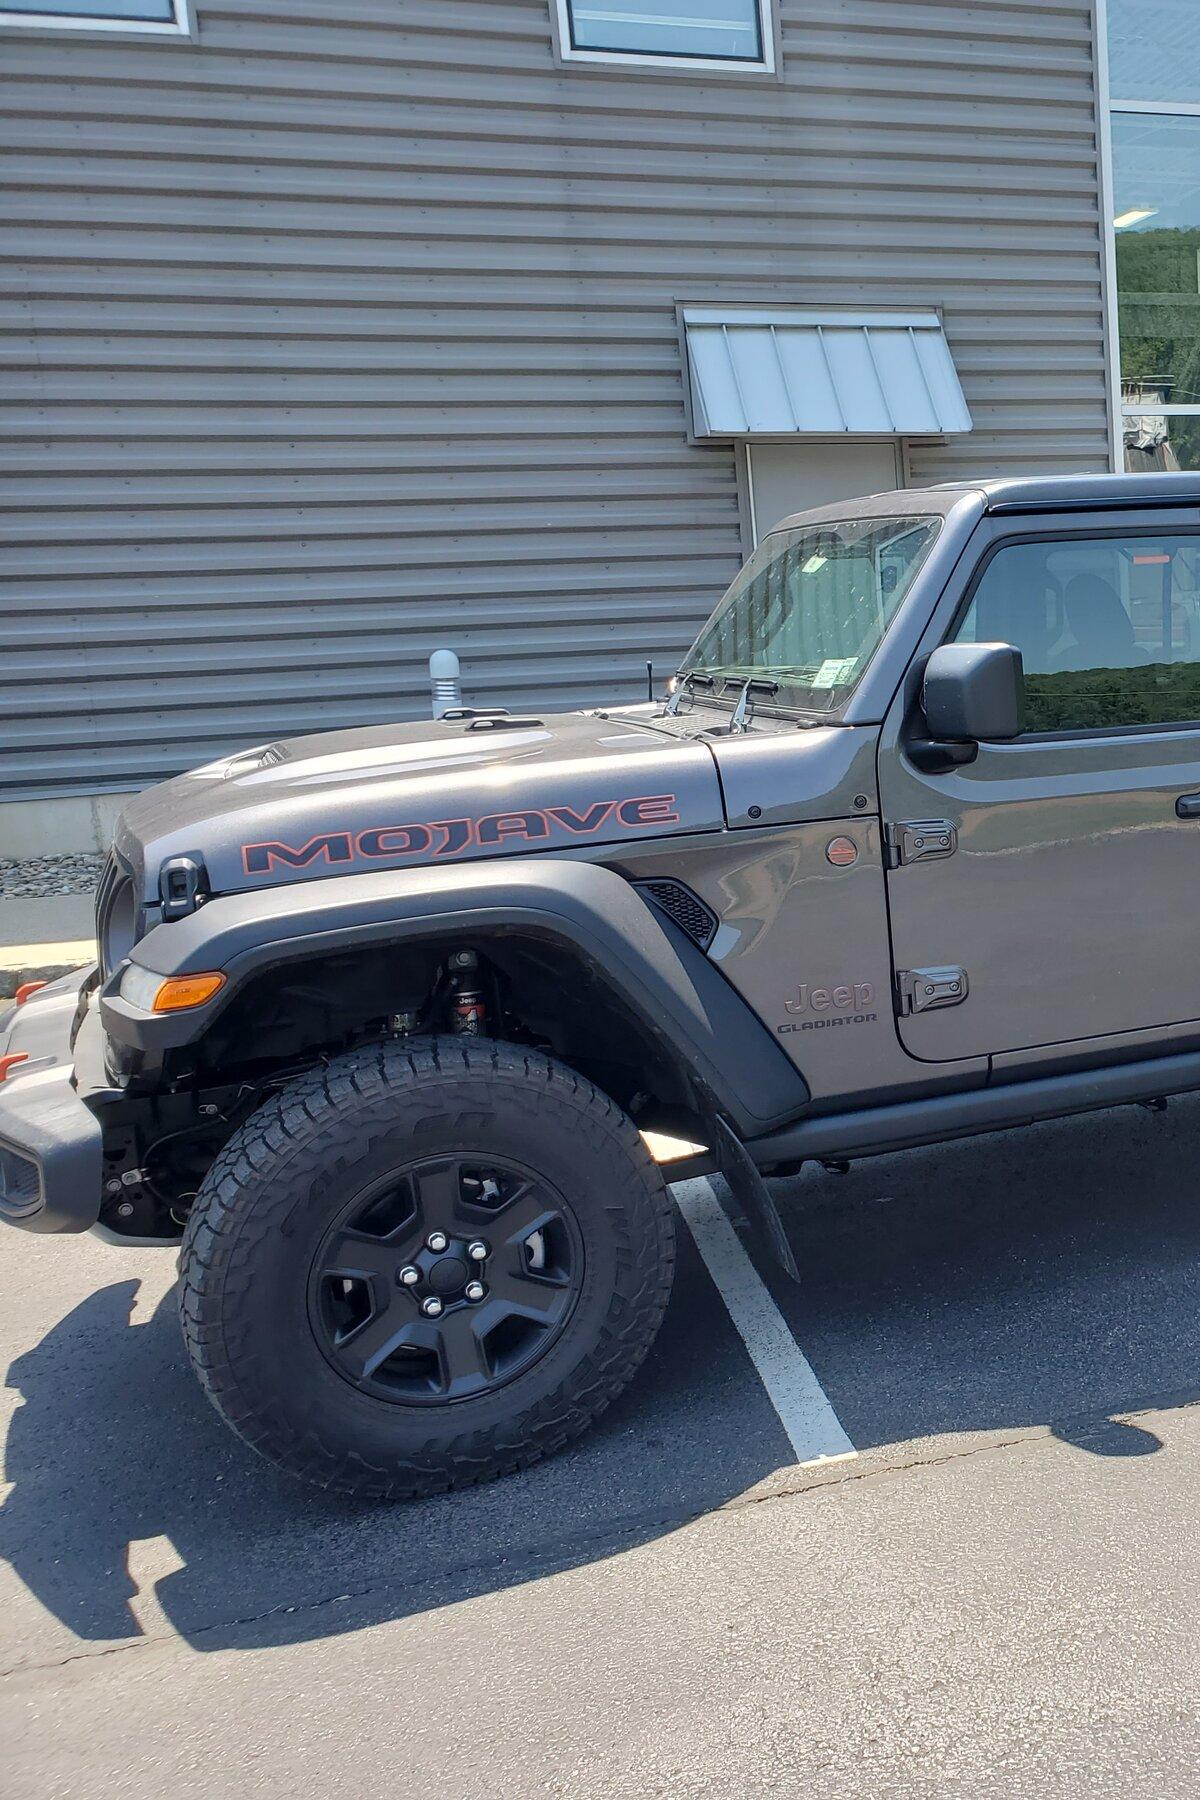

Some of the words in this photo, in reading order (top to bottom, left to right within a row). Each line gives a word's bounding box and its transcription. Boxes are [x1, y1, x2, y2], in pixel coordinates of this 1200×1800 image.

[241, 794, 679, 876] MOJAVE
[784, 982, 876, 1015] Jeep
[777, 1013, 878, 1034] GLADIATOR
